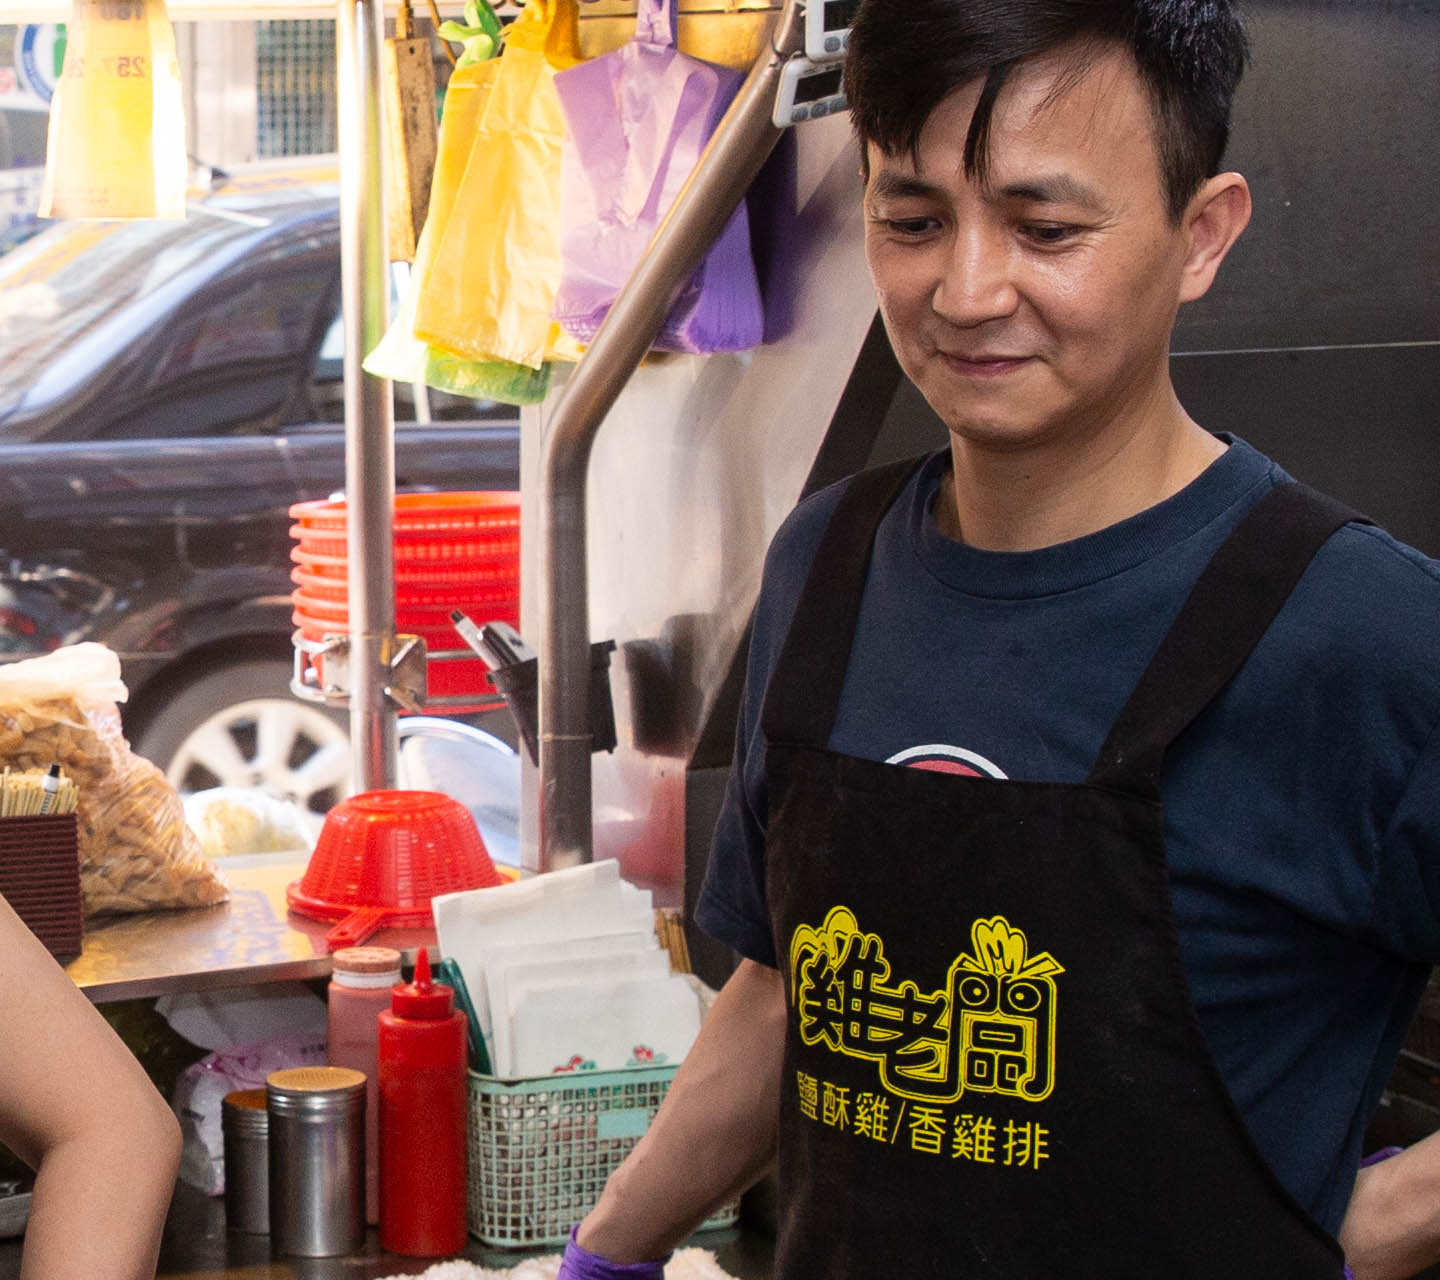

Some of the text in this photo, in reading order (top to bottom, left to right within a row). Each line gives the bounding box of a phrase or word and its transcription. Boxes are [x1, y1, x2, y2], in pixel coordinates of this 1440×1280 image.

[796, 1069, 1051, 1171] 鹽酥雞/香雞排
